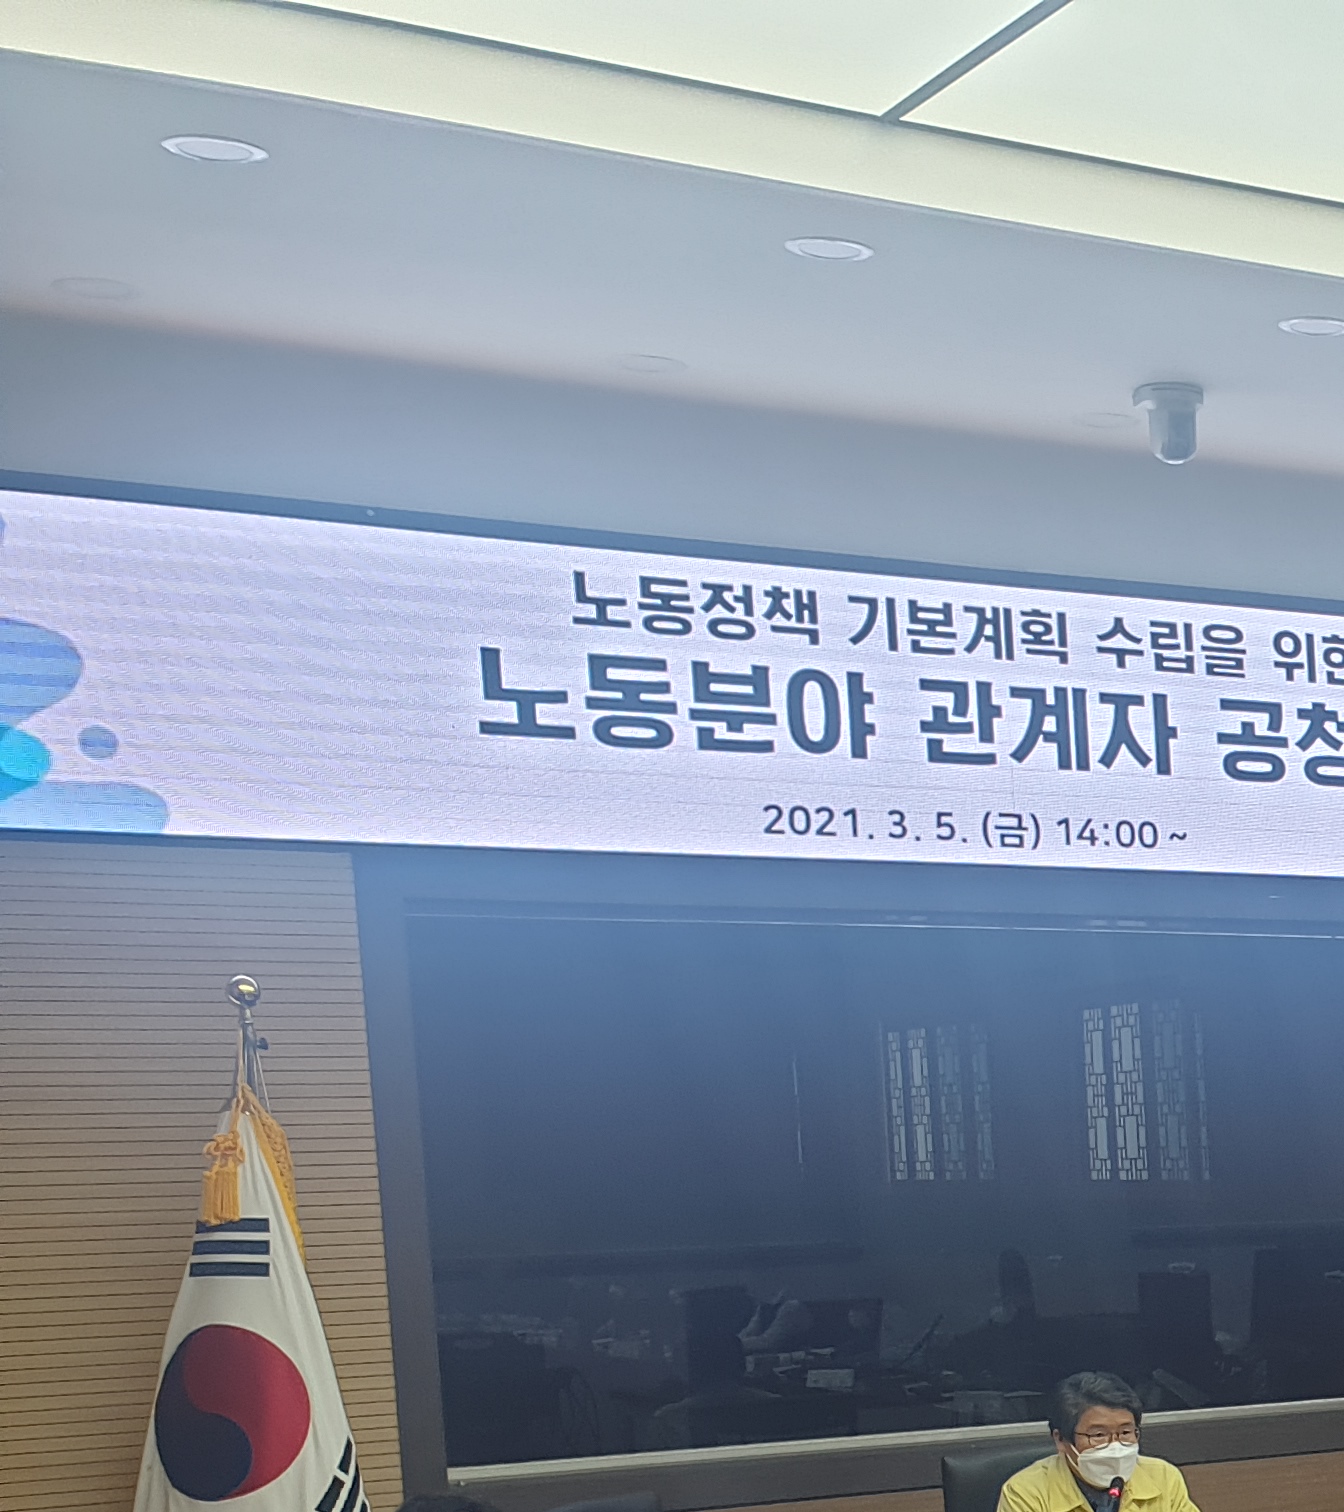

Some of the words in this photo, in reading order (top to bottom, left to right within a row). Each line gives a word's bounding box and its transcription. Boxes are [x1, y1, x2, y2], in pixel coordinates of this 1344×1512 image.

[572, 570, 820, 646] 노동정책
[847, 594, 1069, 666] 기본계획
[1095, 617, 1248, 679] 수립을
[479, 646, 876, 760] 노동분야
[919, 678, 1179, 776] 관계자
[763, 804, 874, 840] 2021.
[887, 808, 921, 842] 3.
[935, 810, 968, 843] 5.
[982, 811, 1042, 850] (금)
